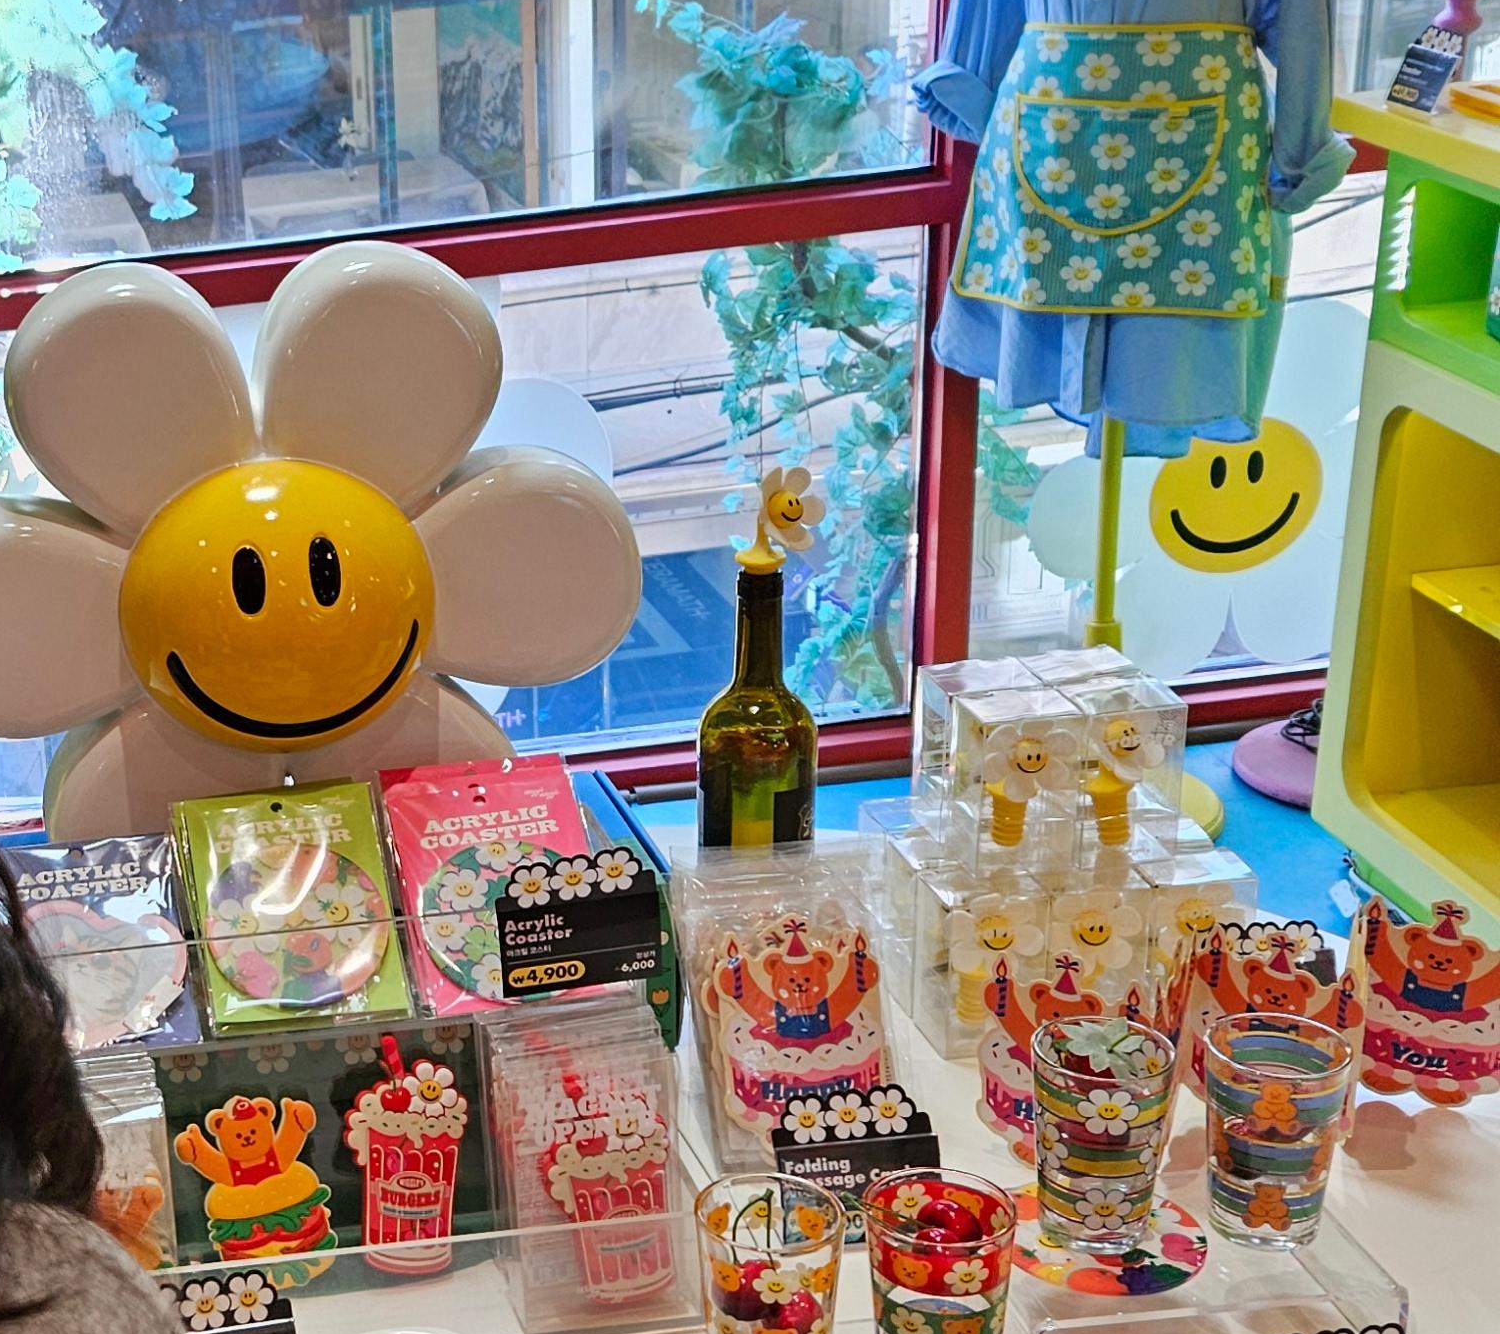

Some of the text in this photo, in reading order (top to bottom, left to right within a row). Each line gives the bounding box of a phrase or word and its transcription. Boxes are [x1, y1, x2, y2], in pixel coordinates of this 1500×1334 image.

[217, 813, 343, 839] ACRYLIC
[424, 804, 549, 834] ACRYLIC
[419, 819, 560, 850] COASTER
[17, 860, 142, 888] ACRYLIC
[15, 875, 149, 903] COASTER
[504, 913, 565, 933] Acrylic
[505, 927, 573, 946] Coaster
[1391, 1042, 1448, 1072] You
[783, 1157, 851, 1176] Folding
